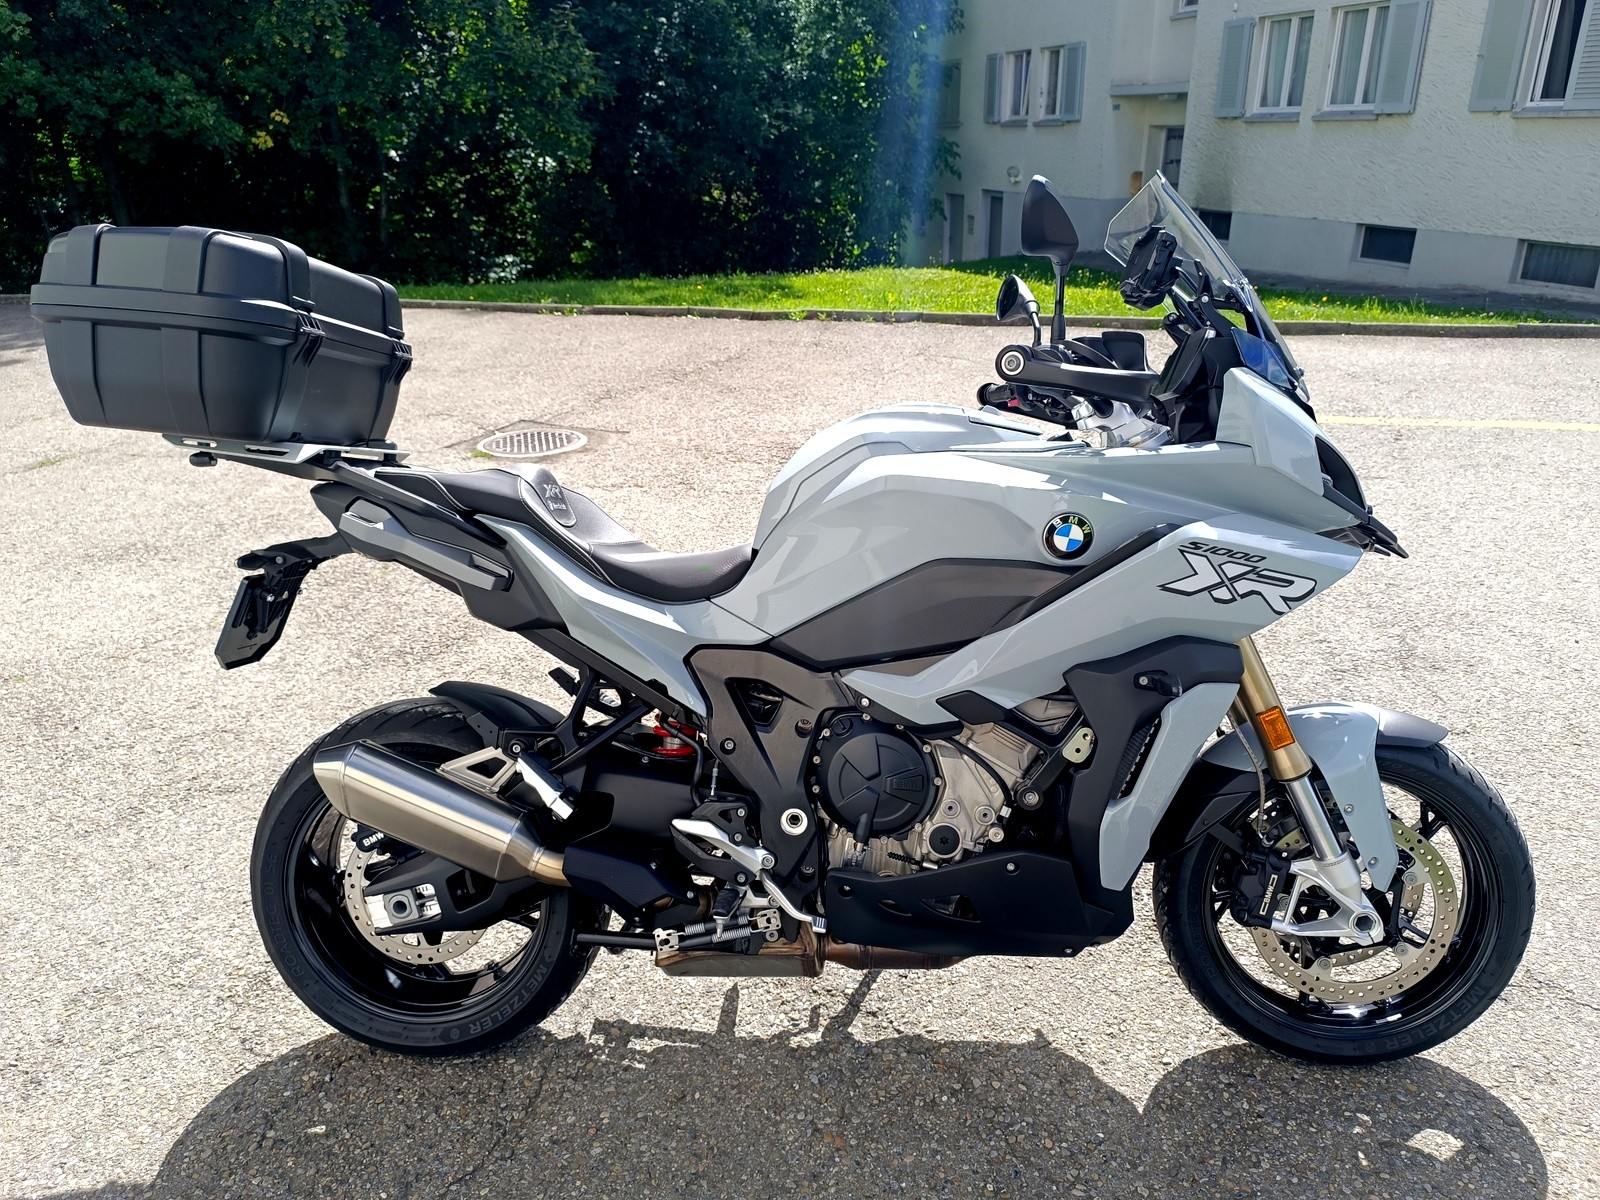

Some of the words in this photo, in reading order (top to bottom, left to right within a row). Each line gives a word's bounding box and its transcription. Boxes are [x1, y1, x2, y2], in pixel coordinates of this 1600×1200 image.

[1052, 515, 1093, 535] BMW
[1179, 540, 1267, 563] S1000
[1156, 548, 1317, 615] XR
[363, 832, 384, 846] BMW
[266, 904, 304, 977] ROADTEC
[469, 964, 550, 1035] METZELER
[1386, 983, 1488, 1051] METZELER
